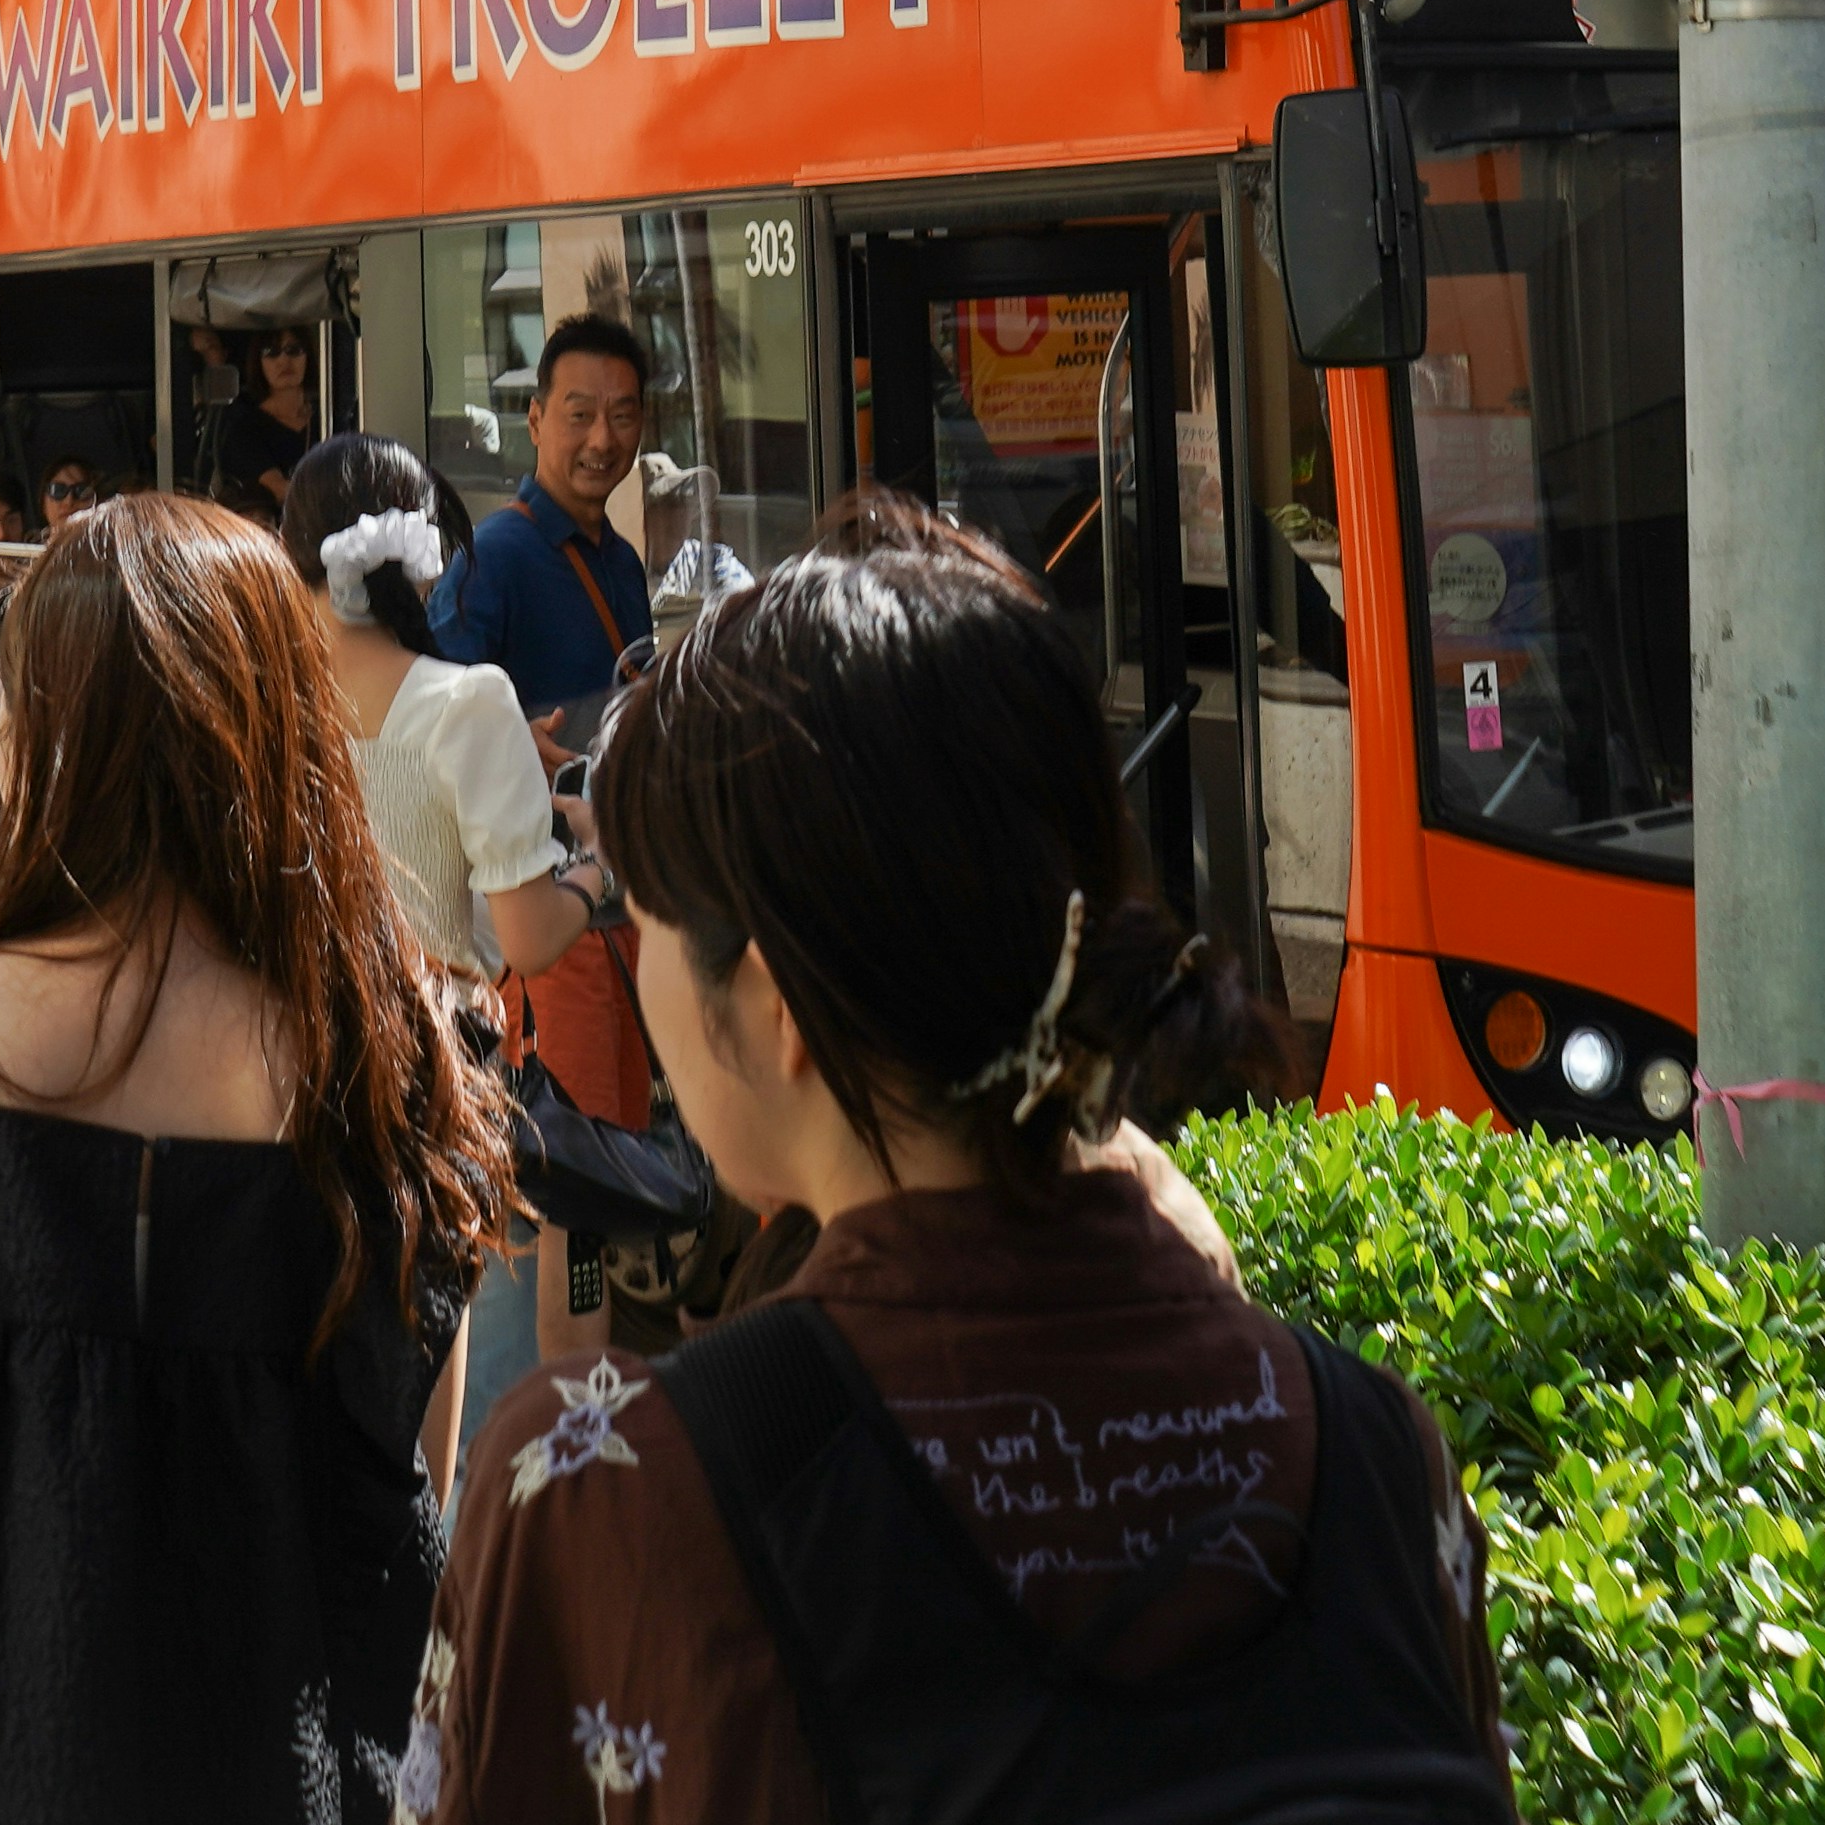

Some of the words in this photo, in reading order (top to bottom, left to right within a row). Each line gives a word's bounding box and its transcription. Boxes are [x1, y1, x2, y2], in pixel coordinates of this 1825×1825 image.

[744, 218, 796, 278] 303
[1074, 329, 1090, 347] IS
[1093, 328, 1114, 346] IN
[1055, 350, 1108, 368] MOTI
[1470, 667, 1493, 700] 4
[1098, 1346, 1288, 1448] measured
[972, 1471, 1059, 1518] the
